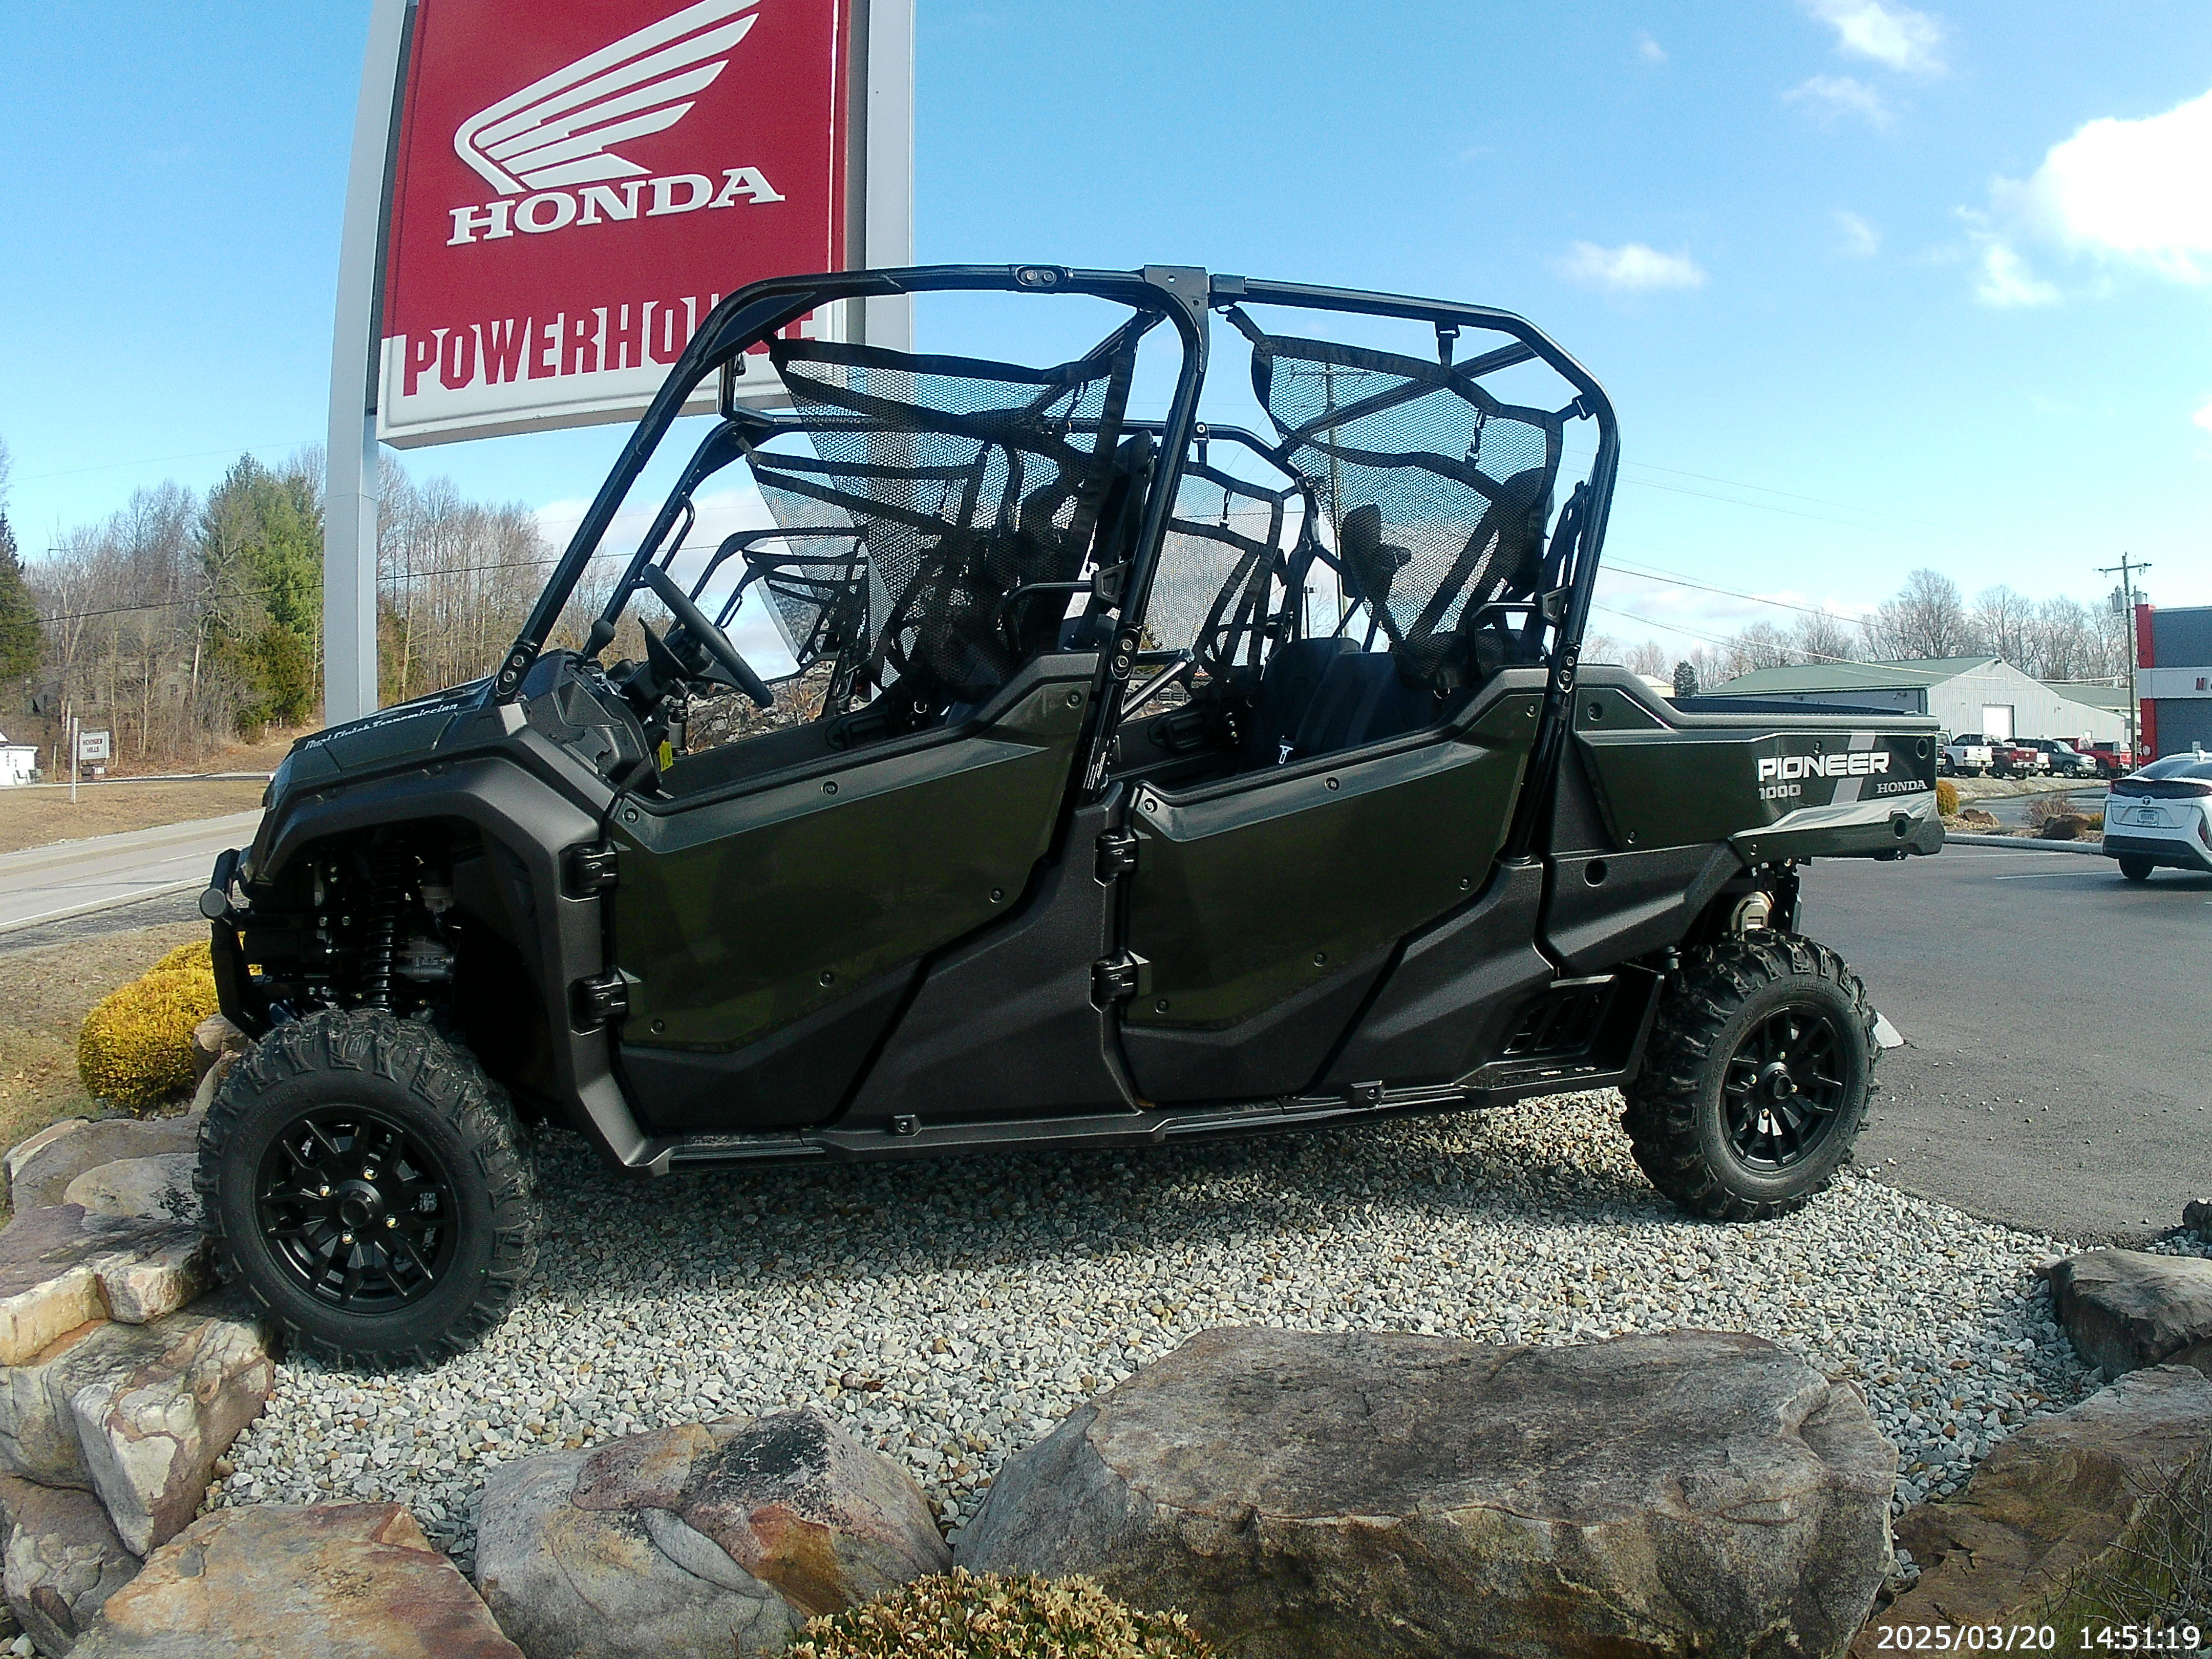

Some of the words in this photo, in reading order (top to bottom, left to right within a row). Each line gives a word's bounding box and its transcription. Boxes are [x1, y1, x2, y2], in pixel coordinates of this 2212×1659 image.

[447, 166, 785, 246] HONDA
[402, 293, 817, 396] POWERHO
[333, 724, 370, 739] Clutch
[372, 704, 458, 728] Transmission
[1758, 752, 1889, 781] PIONEER
[1758, 784, 1802, 800] 1000
[1876, 780, 1928, 794] HONDA
